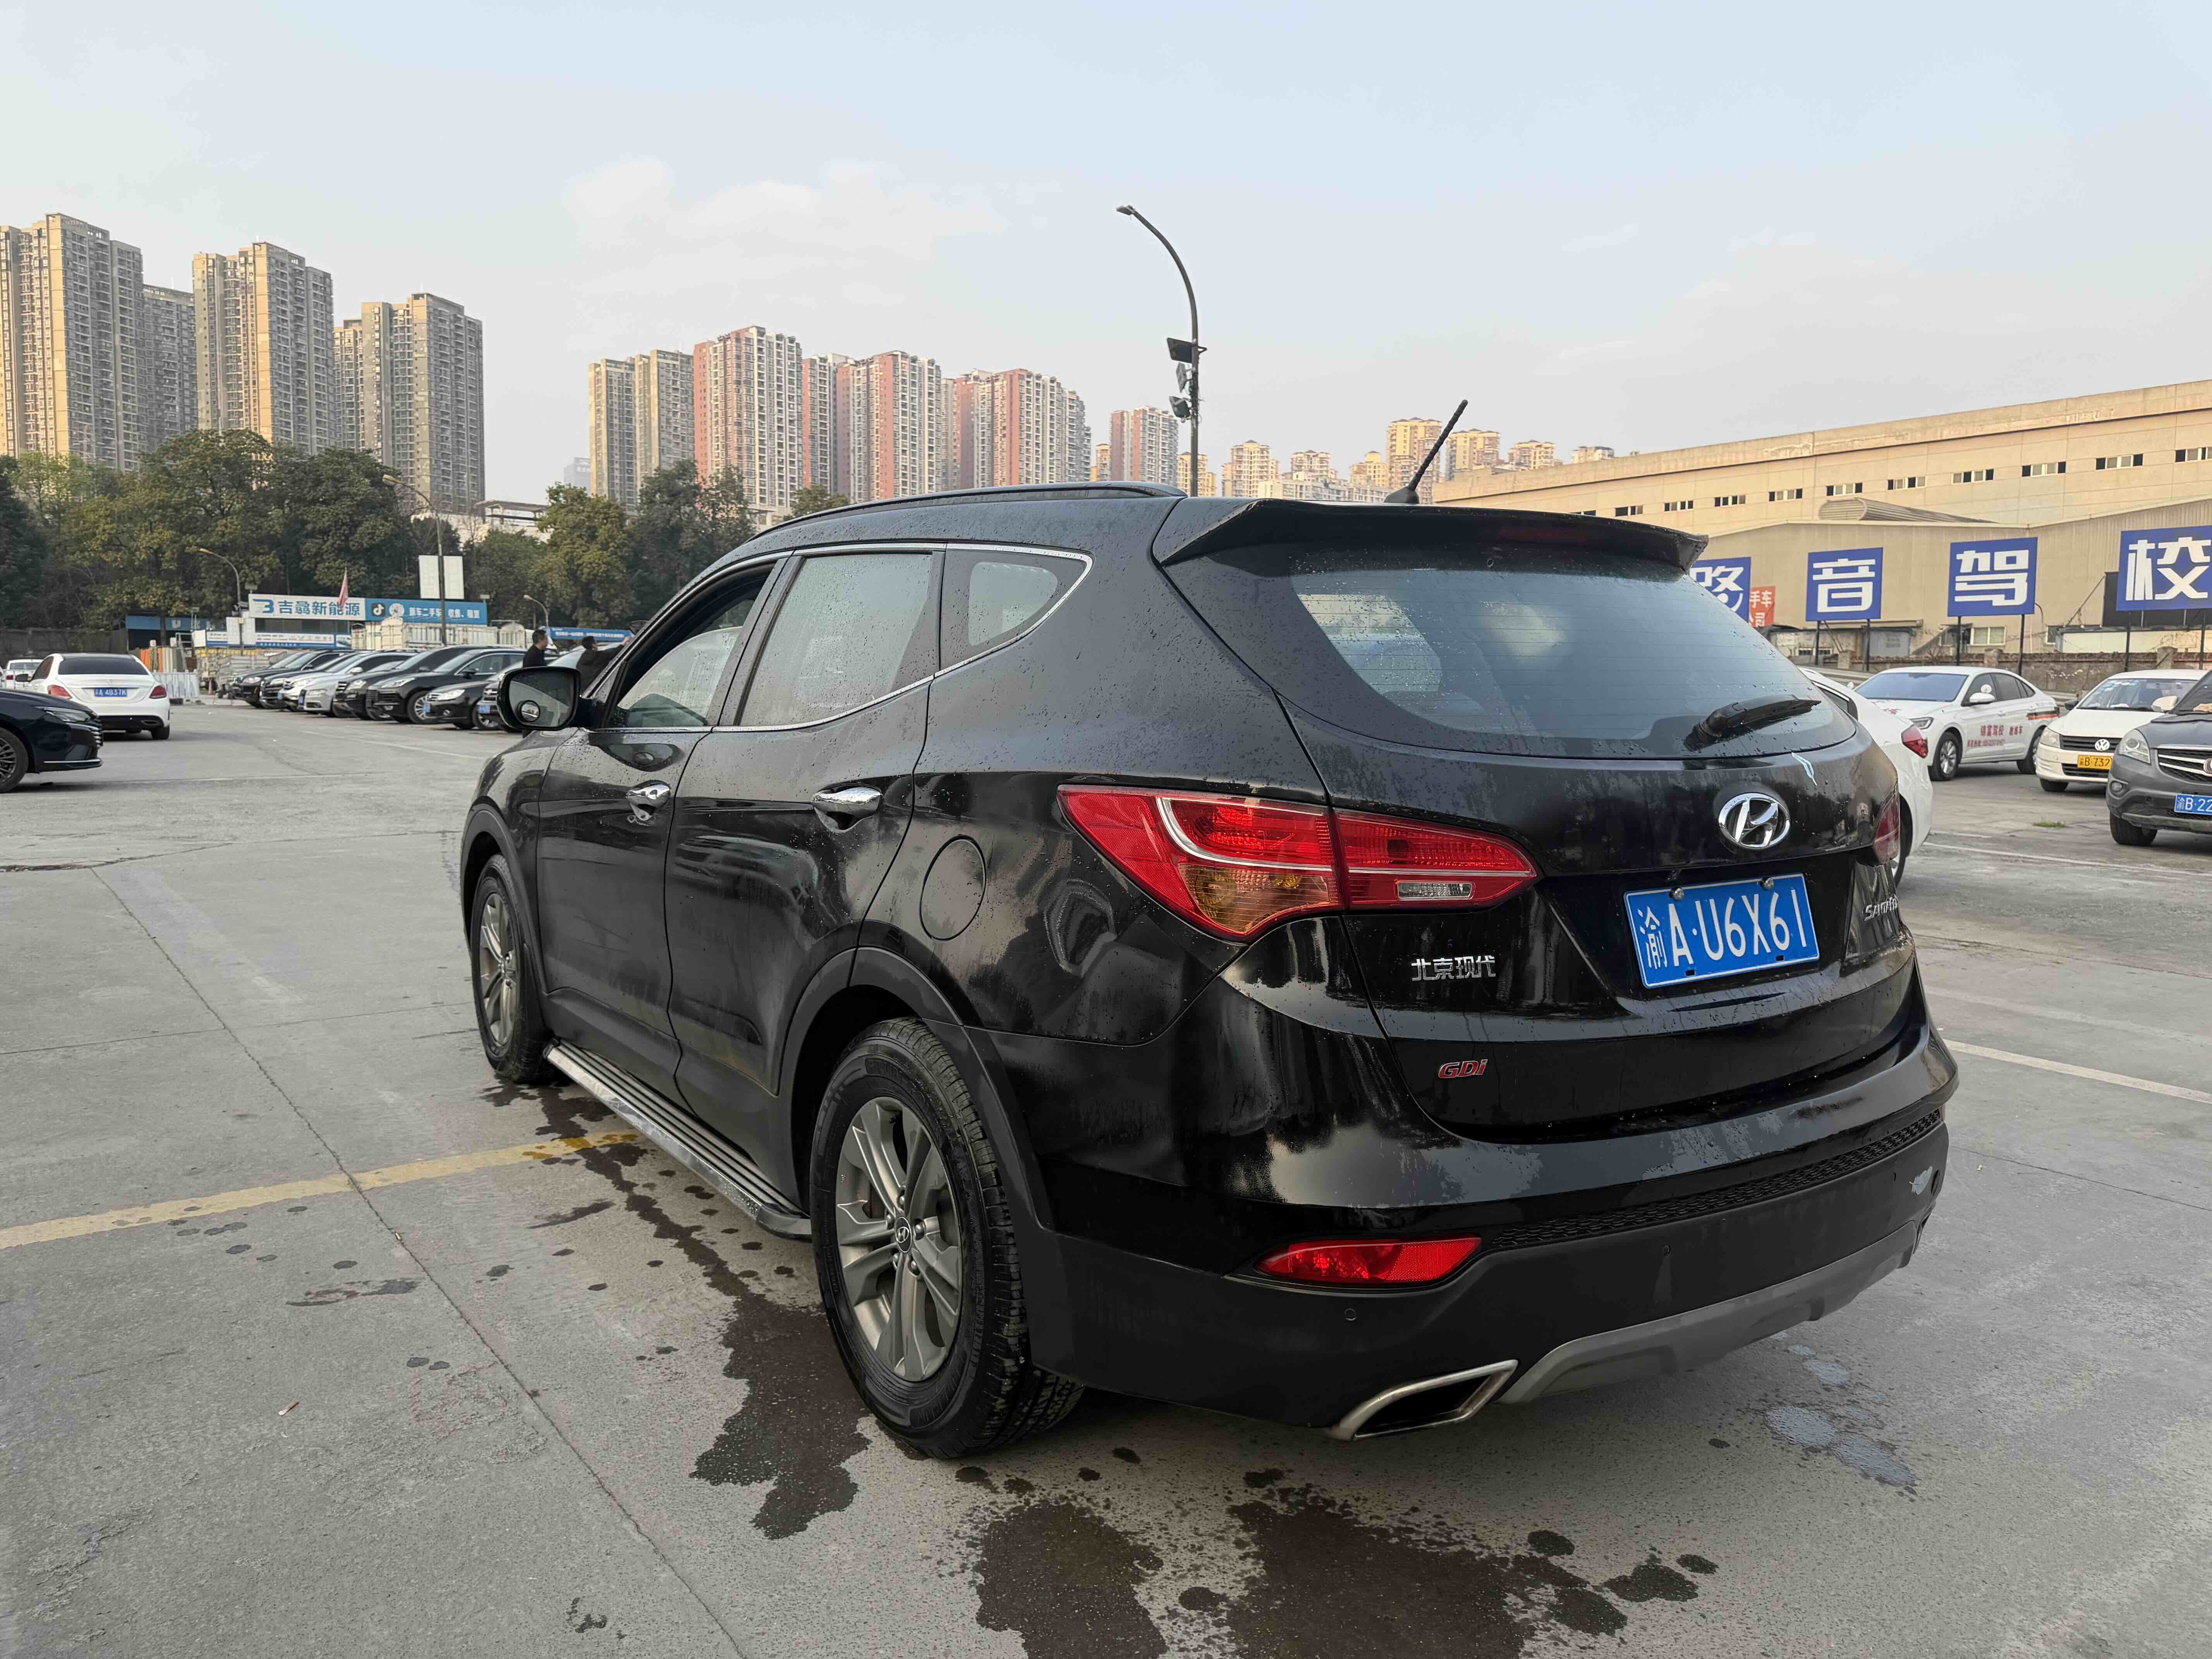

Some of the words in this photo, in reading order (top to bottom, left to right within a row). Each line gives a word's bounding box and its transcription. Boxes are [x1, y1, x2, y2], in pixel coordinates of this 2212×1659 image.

[1812, 558, 1875, 613] 音
[1954, 549, 2029, 606] 驾
[2125, 537, 2212, 601] 校
[1411, 955, 1496, 982] 北京现代
